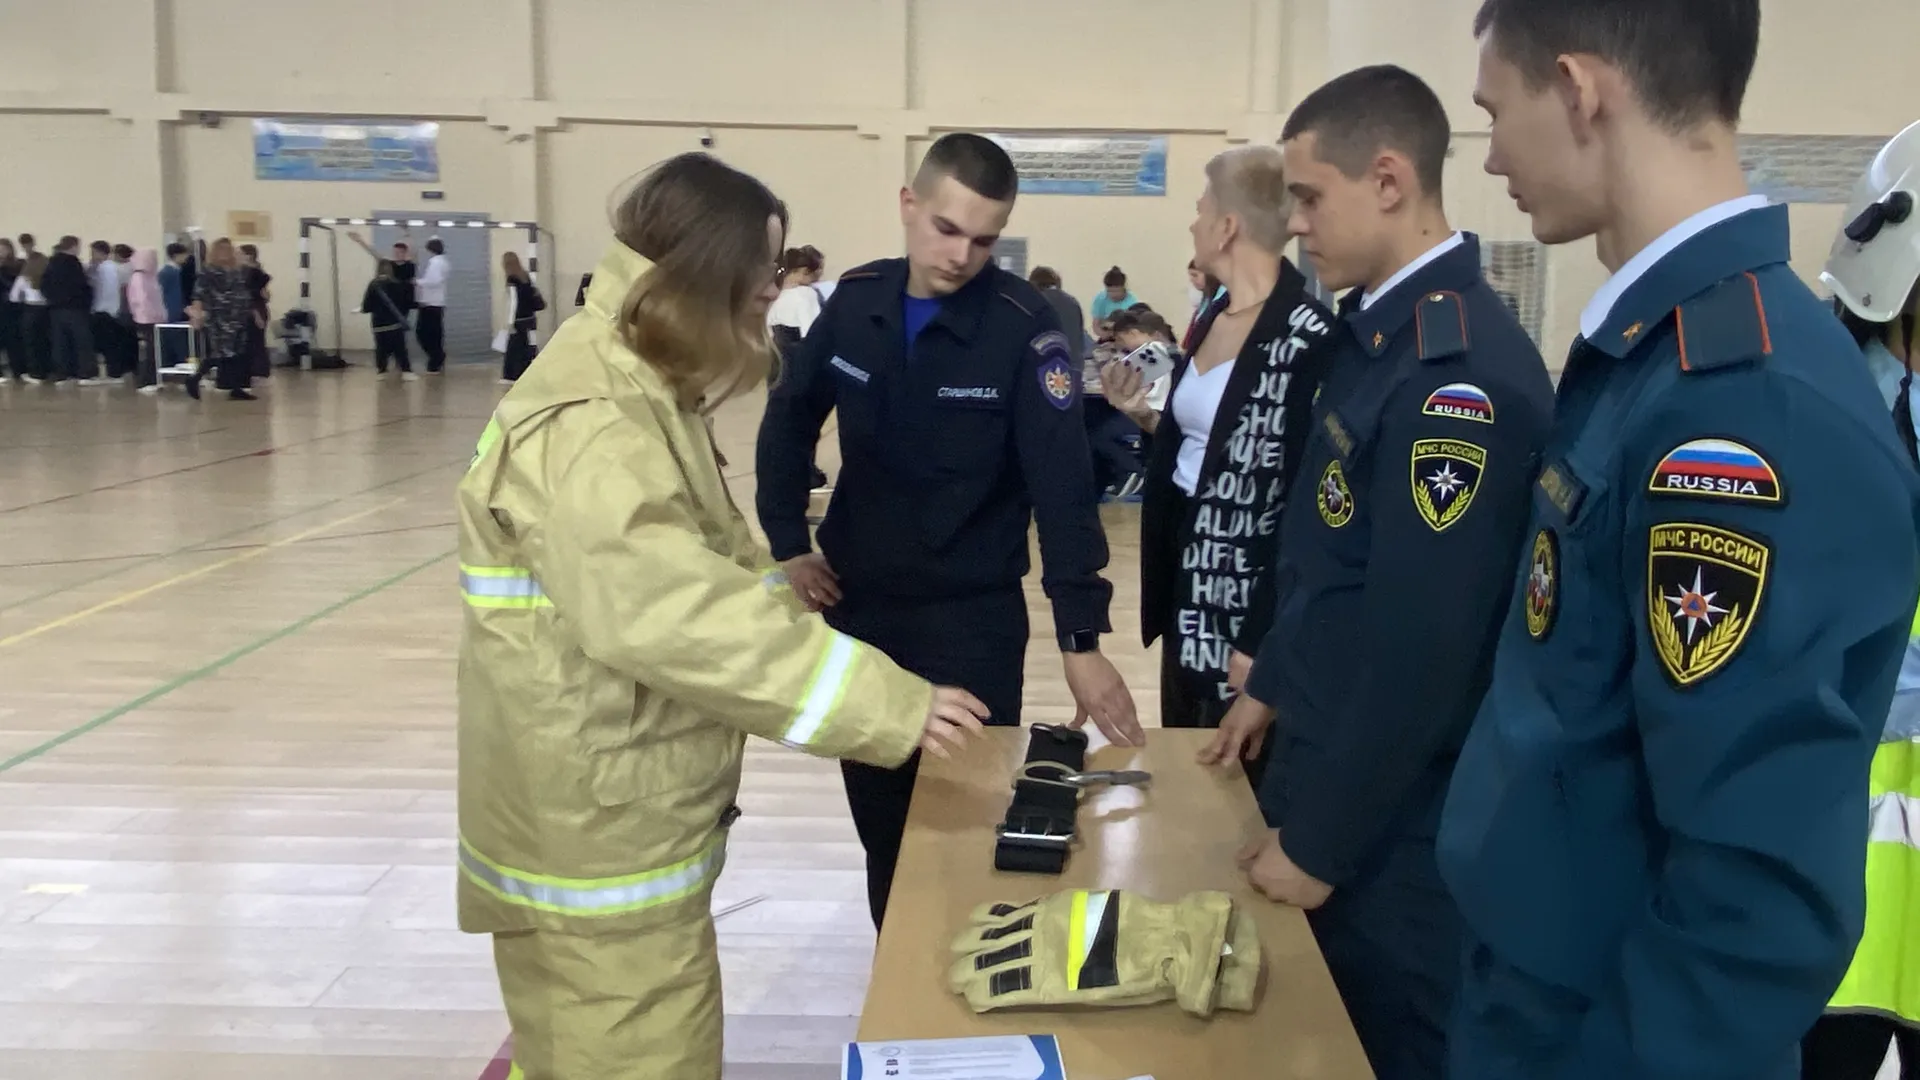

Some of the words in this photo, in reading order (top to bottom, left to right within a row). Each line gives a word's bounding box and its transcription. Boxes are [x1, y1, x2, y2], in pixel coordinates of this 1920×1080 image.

[1434, 404, 1485, 419] RUSSIA
[1416, 445, 1439, 455] МЧС
[1440, 445, 1482, 461] РОССИИ
[1667, 474, 1758, 495] RUSSIA
[1654, 530, 1686, 548] МЧС
[1690, 531, 1761, 567] РОССИИ
